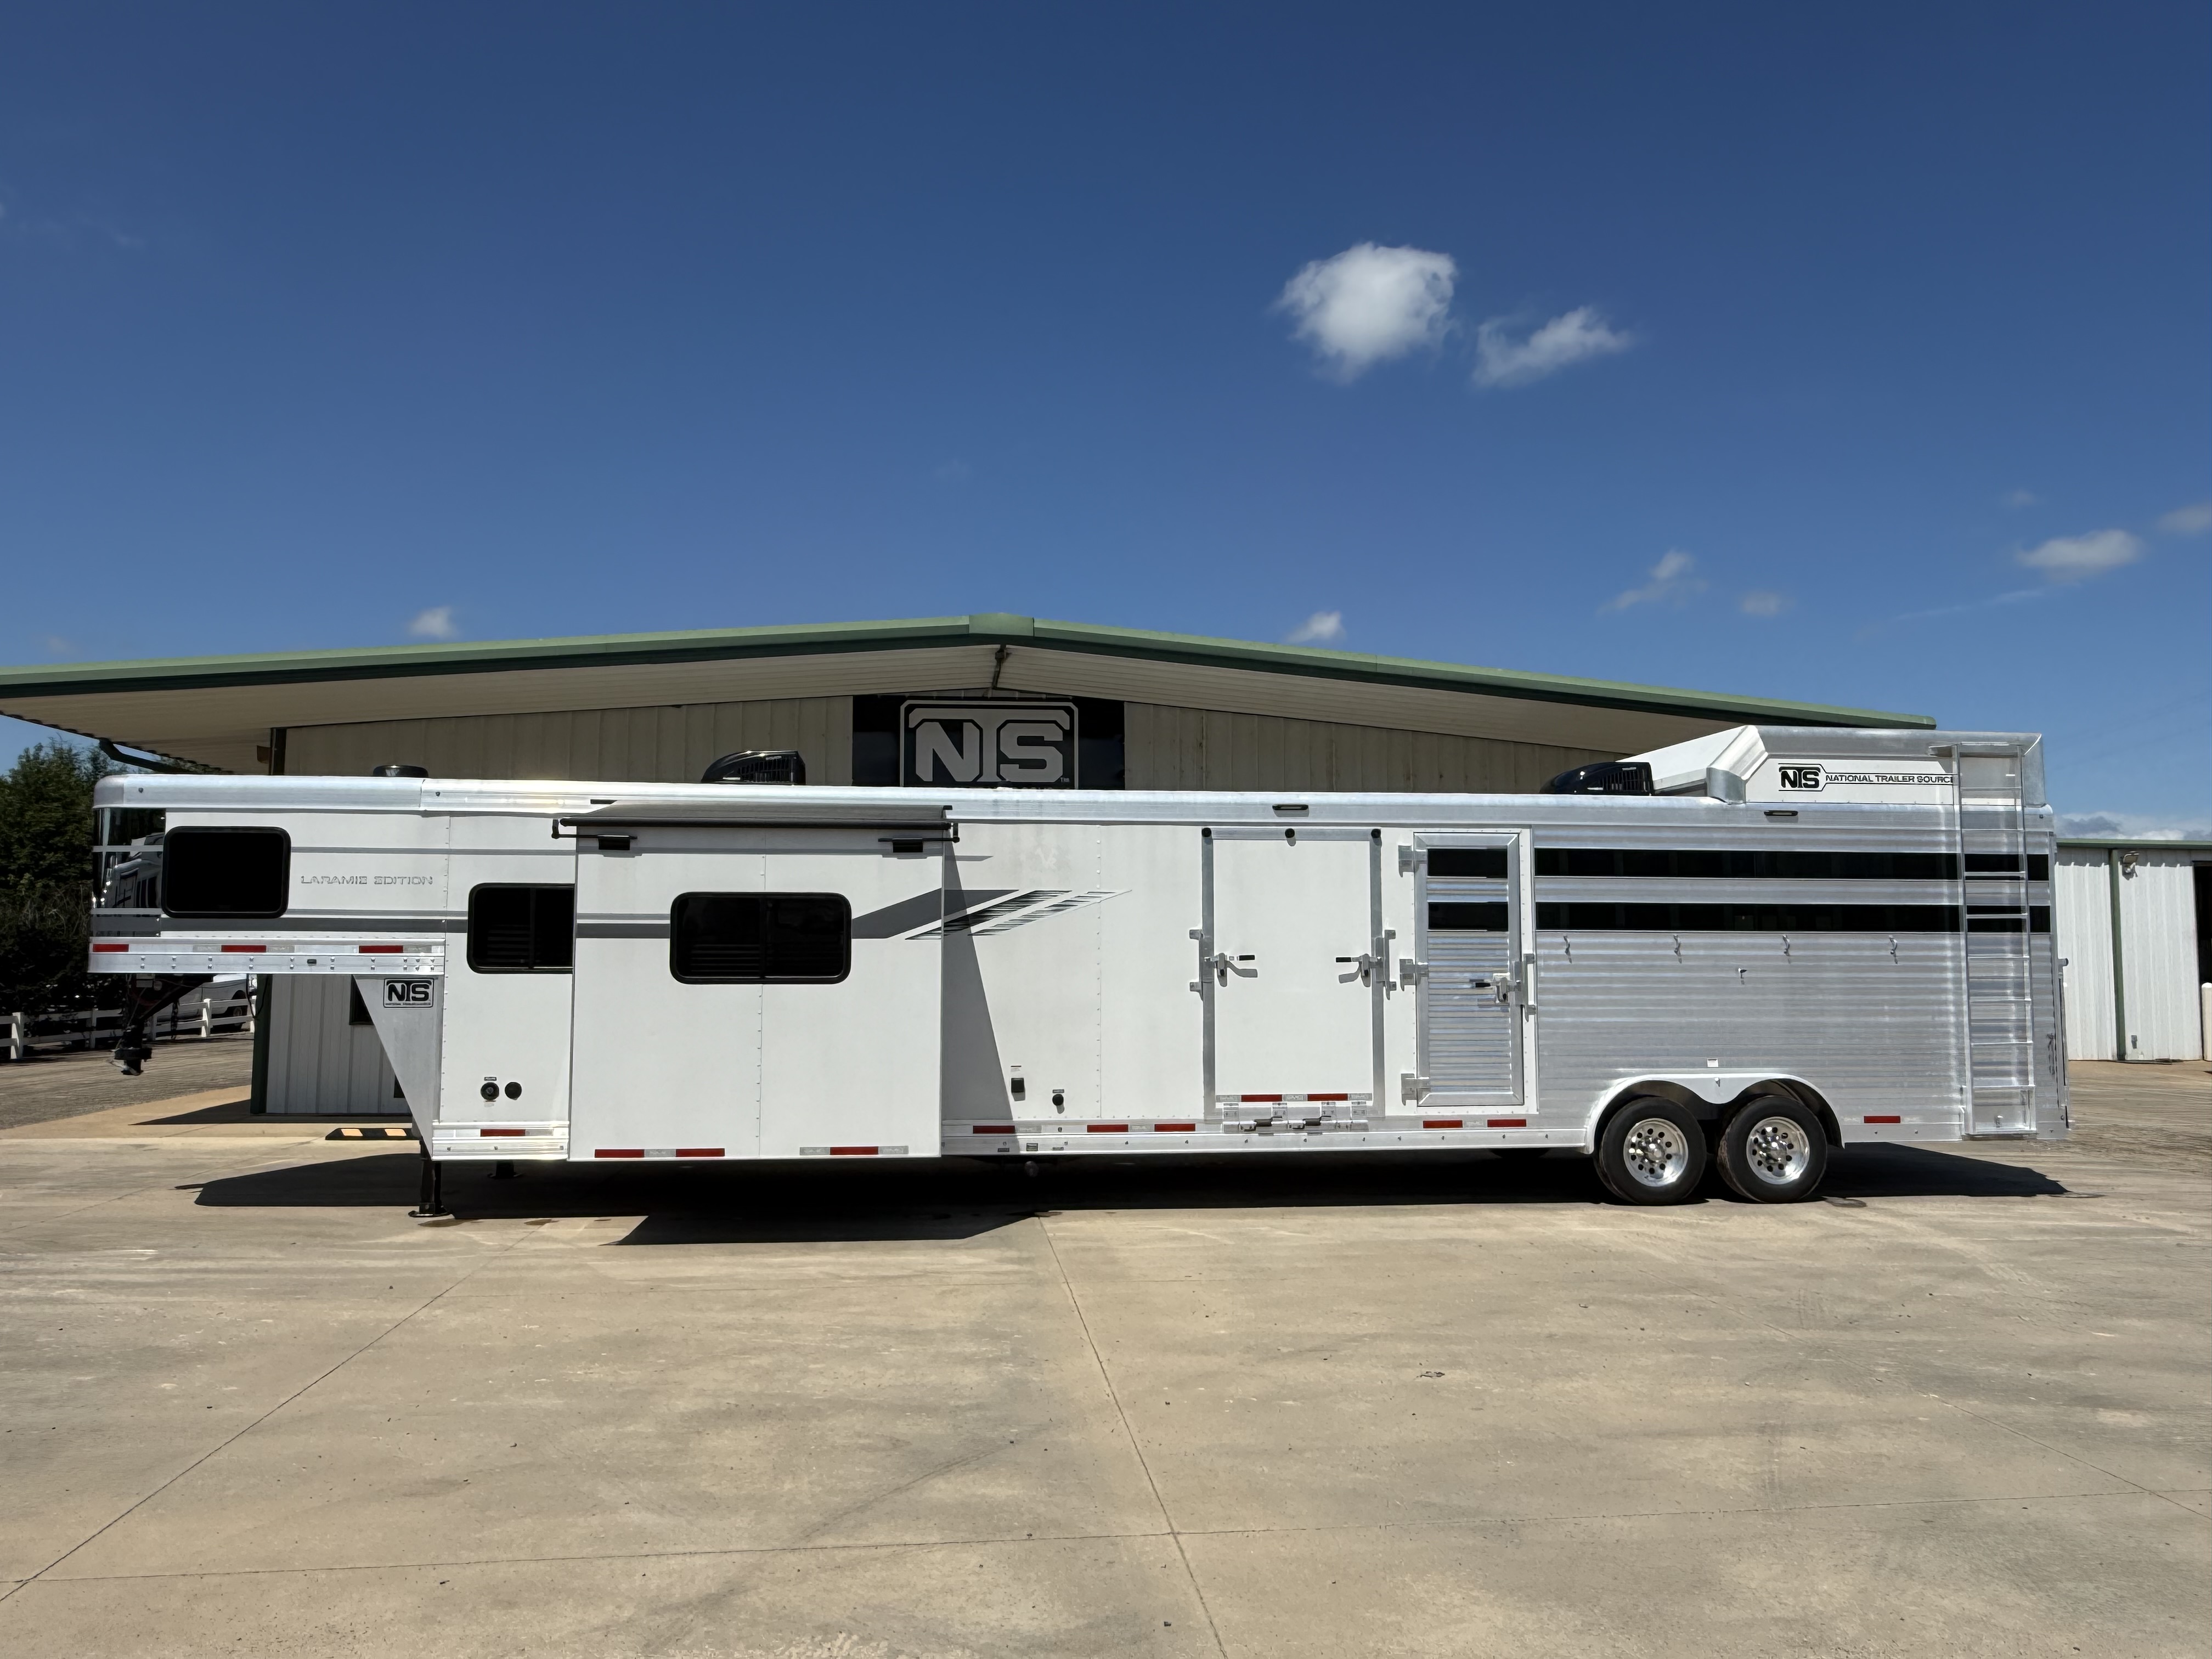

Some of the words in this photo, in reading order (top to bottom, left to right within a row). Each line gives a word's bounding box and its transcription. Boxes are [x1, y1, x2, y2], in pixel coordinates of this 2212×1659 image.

[908, 708, 1070, 783] NTS
[1779, 766, 1821, 788] NTS
[1875, 775, 1915, 783] TRAILER
[301, 876, 368, 885] LARAMIE
[374, 876, 433, 885] EDITION
[386, 980, 432, 1002] NTS
